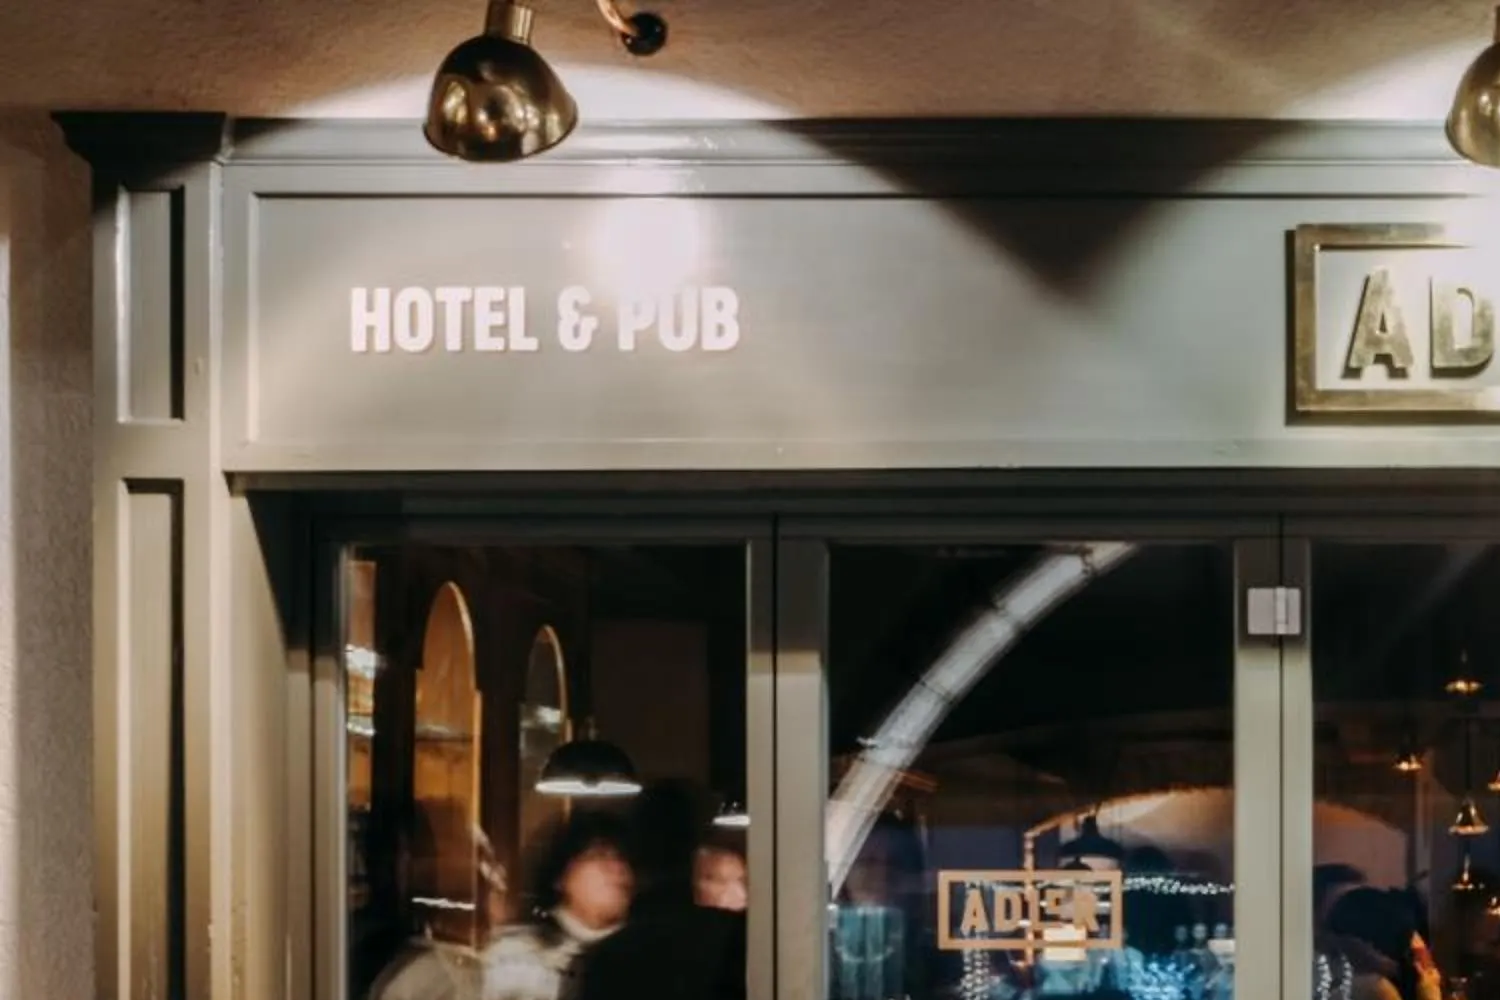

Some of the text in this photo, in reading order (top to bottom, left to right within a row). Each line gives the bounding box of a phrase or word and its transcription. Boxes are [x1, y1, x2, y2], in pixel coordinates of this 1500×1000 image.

[350, 285, 740, 352] HOTEL & PUB
[961, 886, 1100, 934] ADLER
